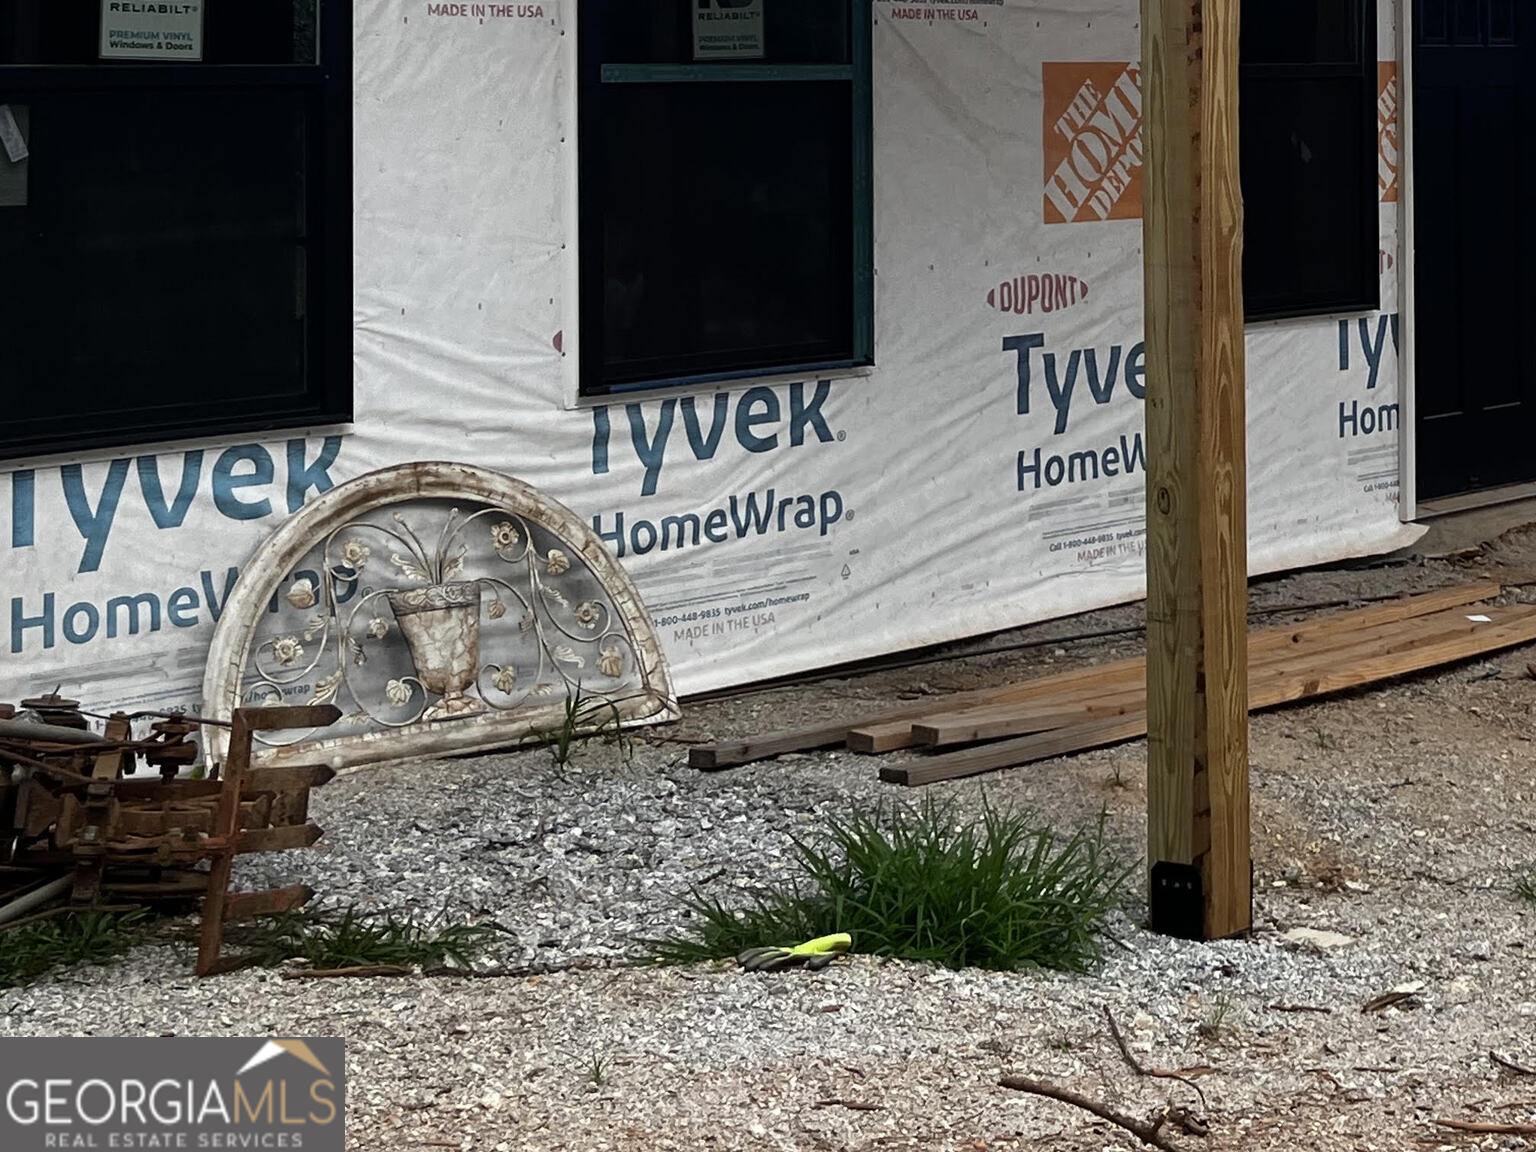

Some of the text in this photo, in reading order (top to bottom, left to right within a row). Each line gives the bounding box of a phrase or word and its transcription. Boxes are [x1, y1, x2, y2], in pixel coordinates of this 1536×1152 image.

[110, 3, 191, 14] RELIABILT
[427, 4, 543, 18] MADE IN THE USA
[891, 8, 979, 21] MADE IN THE USA
[109, 30, 193, 41] PREMIUM VINYL
[110, 40, 154, 50] Windows
[166, 41, 193, 51] Doors
[1054, 77, 1102, 143] THE
[1000, 274, 1077, 314] DUPONT
[1002, 332, 1145, 435] Tyve
[592, 379, 835, 497] Tyvek
[1018, 433, 1146, 491] HomeW
[593, 489, 843, 558] HomeWrap
[1077, 547, 1105, 562] MADE
[1106, 545, 1117, 557] IN
[1118, 541, 1136, 554] THE
[654, 592, 810, 628] 1-800-448-9835 tyvek.com/homewrap
[673, 611, 775, 643] MADE IN THE USA
